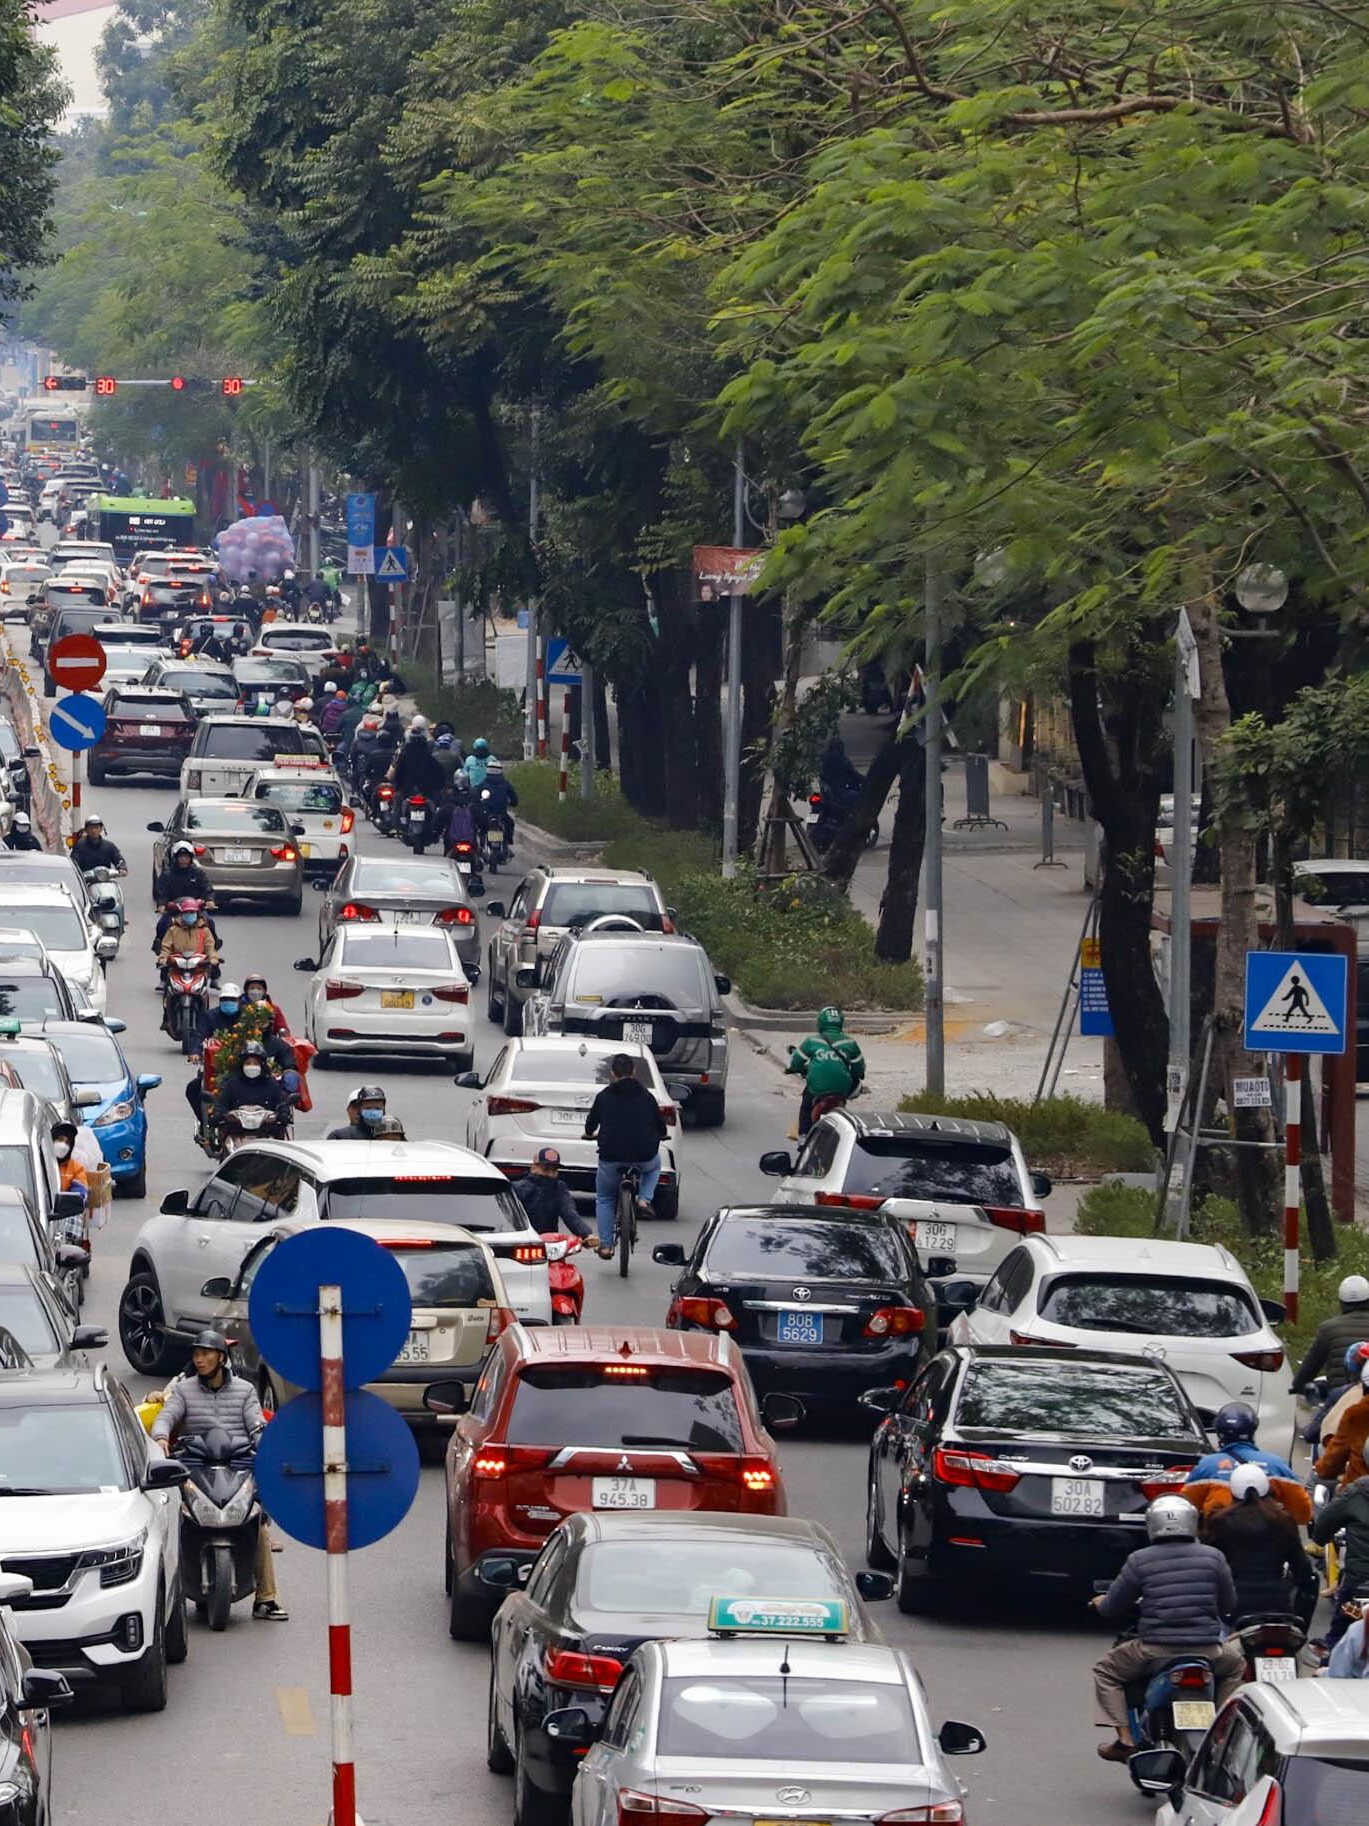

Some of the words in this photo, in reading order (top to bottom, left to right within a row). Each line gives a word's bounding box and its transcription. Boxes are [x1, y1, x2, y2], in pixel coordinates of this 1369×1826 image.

[97, 379, 115, 394] 30
[223, 379, 241, 394] 30
[925, 1223, 947, 1236] 30G
[787, 1314, 814, 1328] 80B
[782, 1328, 818, 1342] 5629
[611, 1478, 637, 1492] 37A
[1064, 1480, 1092, 1496] 30A
[599, 1493, 648, 1507] 945.38
